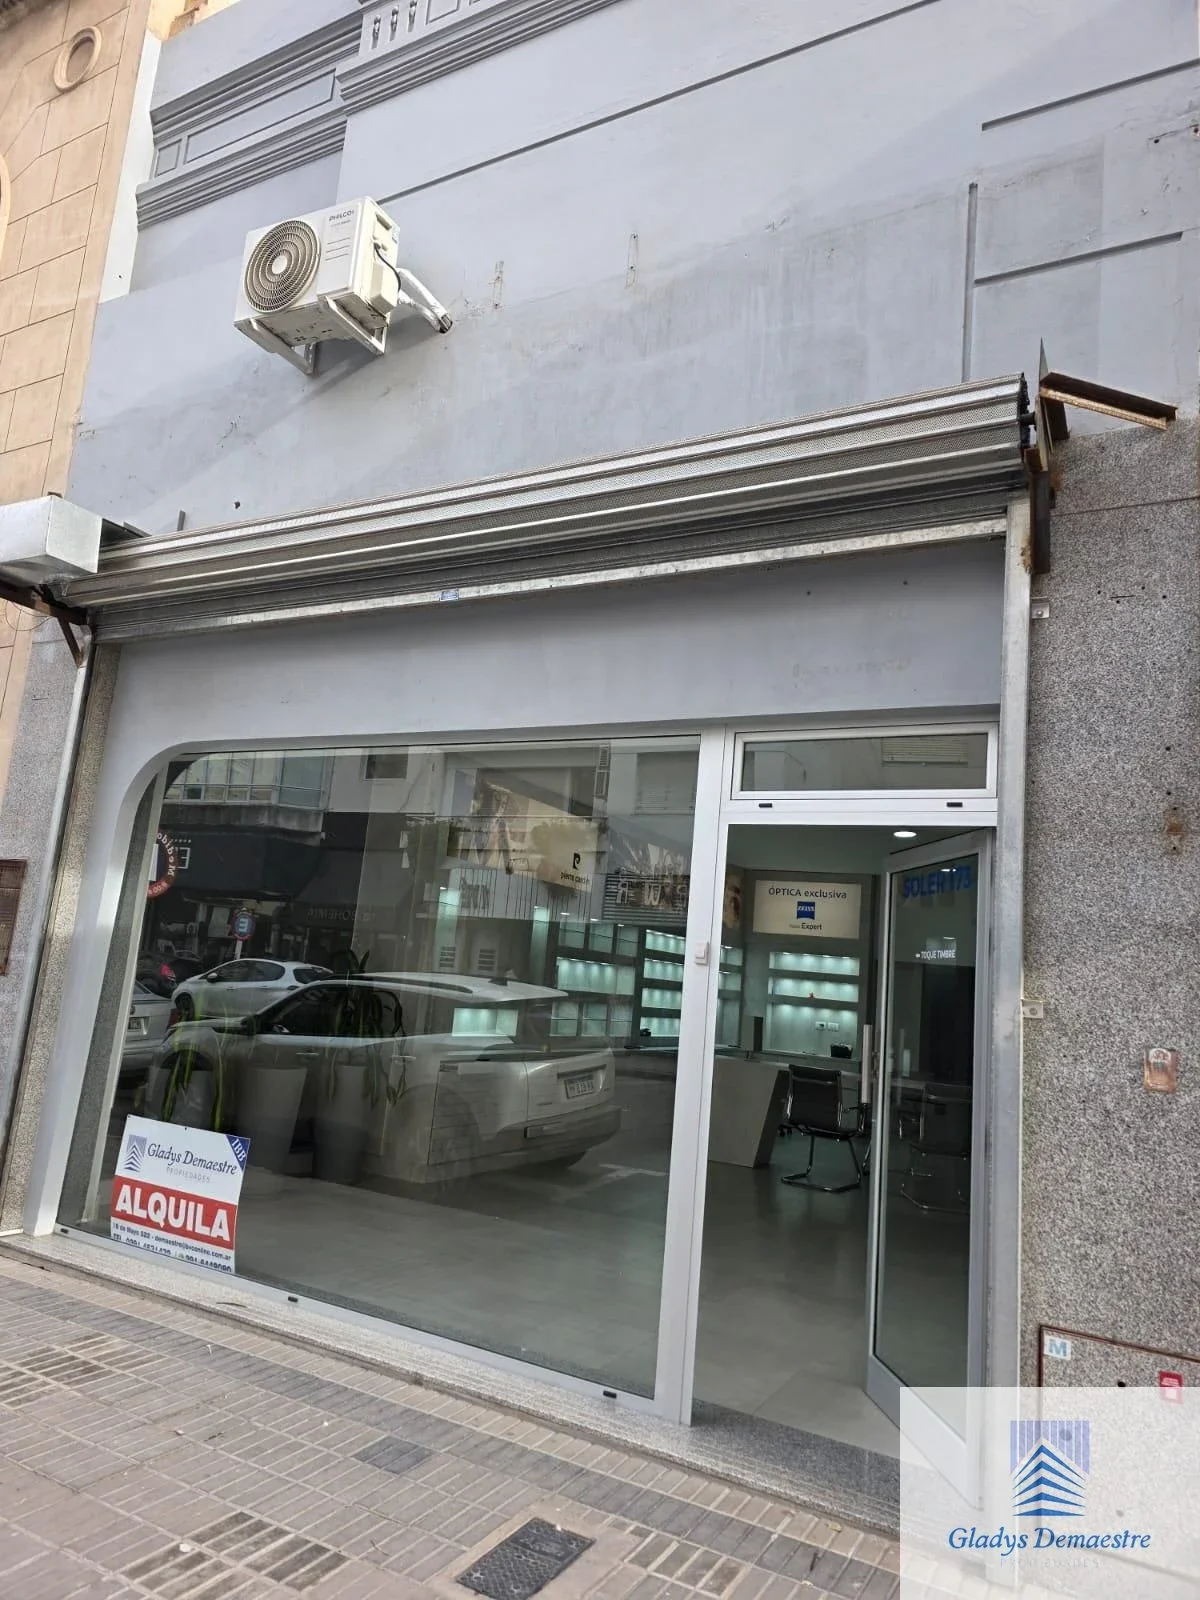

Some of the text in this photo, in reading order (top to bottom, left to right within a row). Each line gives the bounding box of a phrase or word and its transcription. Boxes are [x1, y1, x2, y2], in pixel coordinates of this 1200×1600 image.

[329, 210, 352, 221] PHILCO
[768, 884, 848, 900] ÓPTICA exclusiva
[801, 922, 823, 931] Expert
[148, 1143, 237, 1175] Gladys Demaestre
[231, 1138, 248, 1162] IBB
[115, 1184, 230, 1241] ALQUILA
[1048, 1338, 1067, 1357] M
